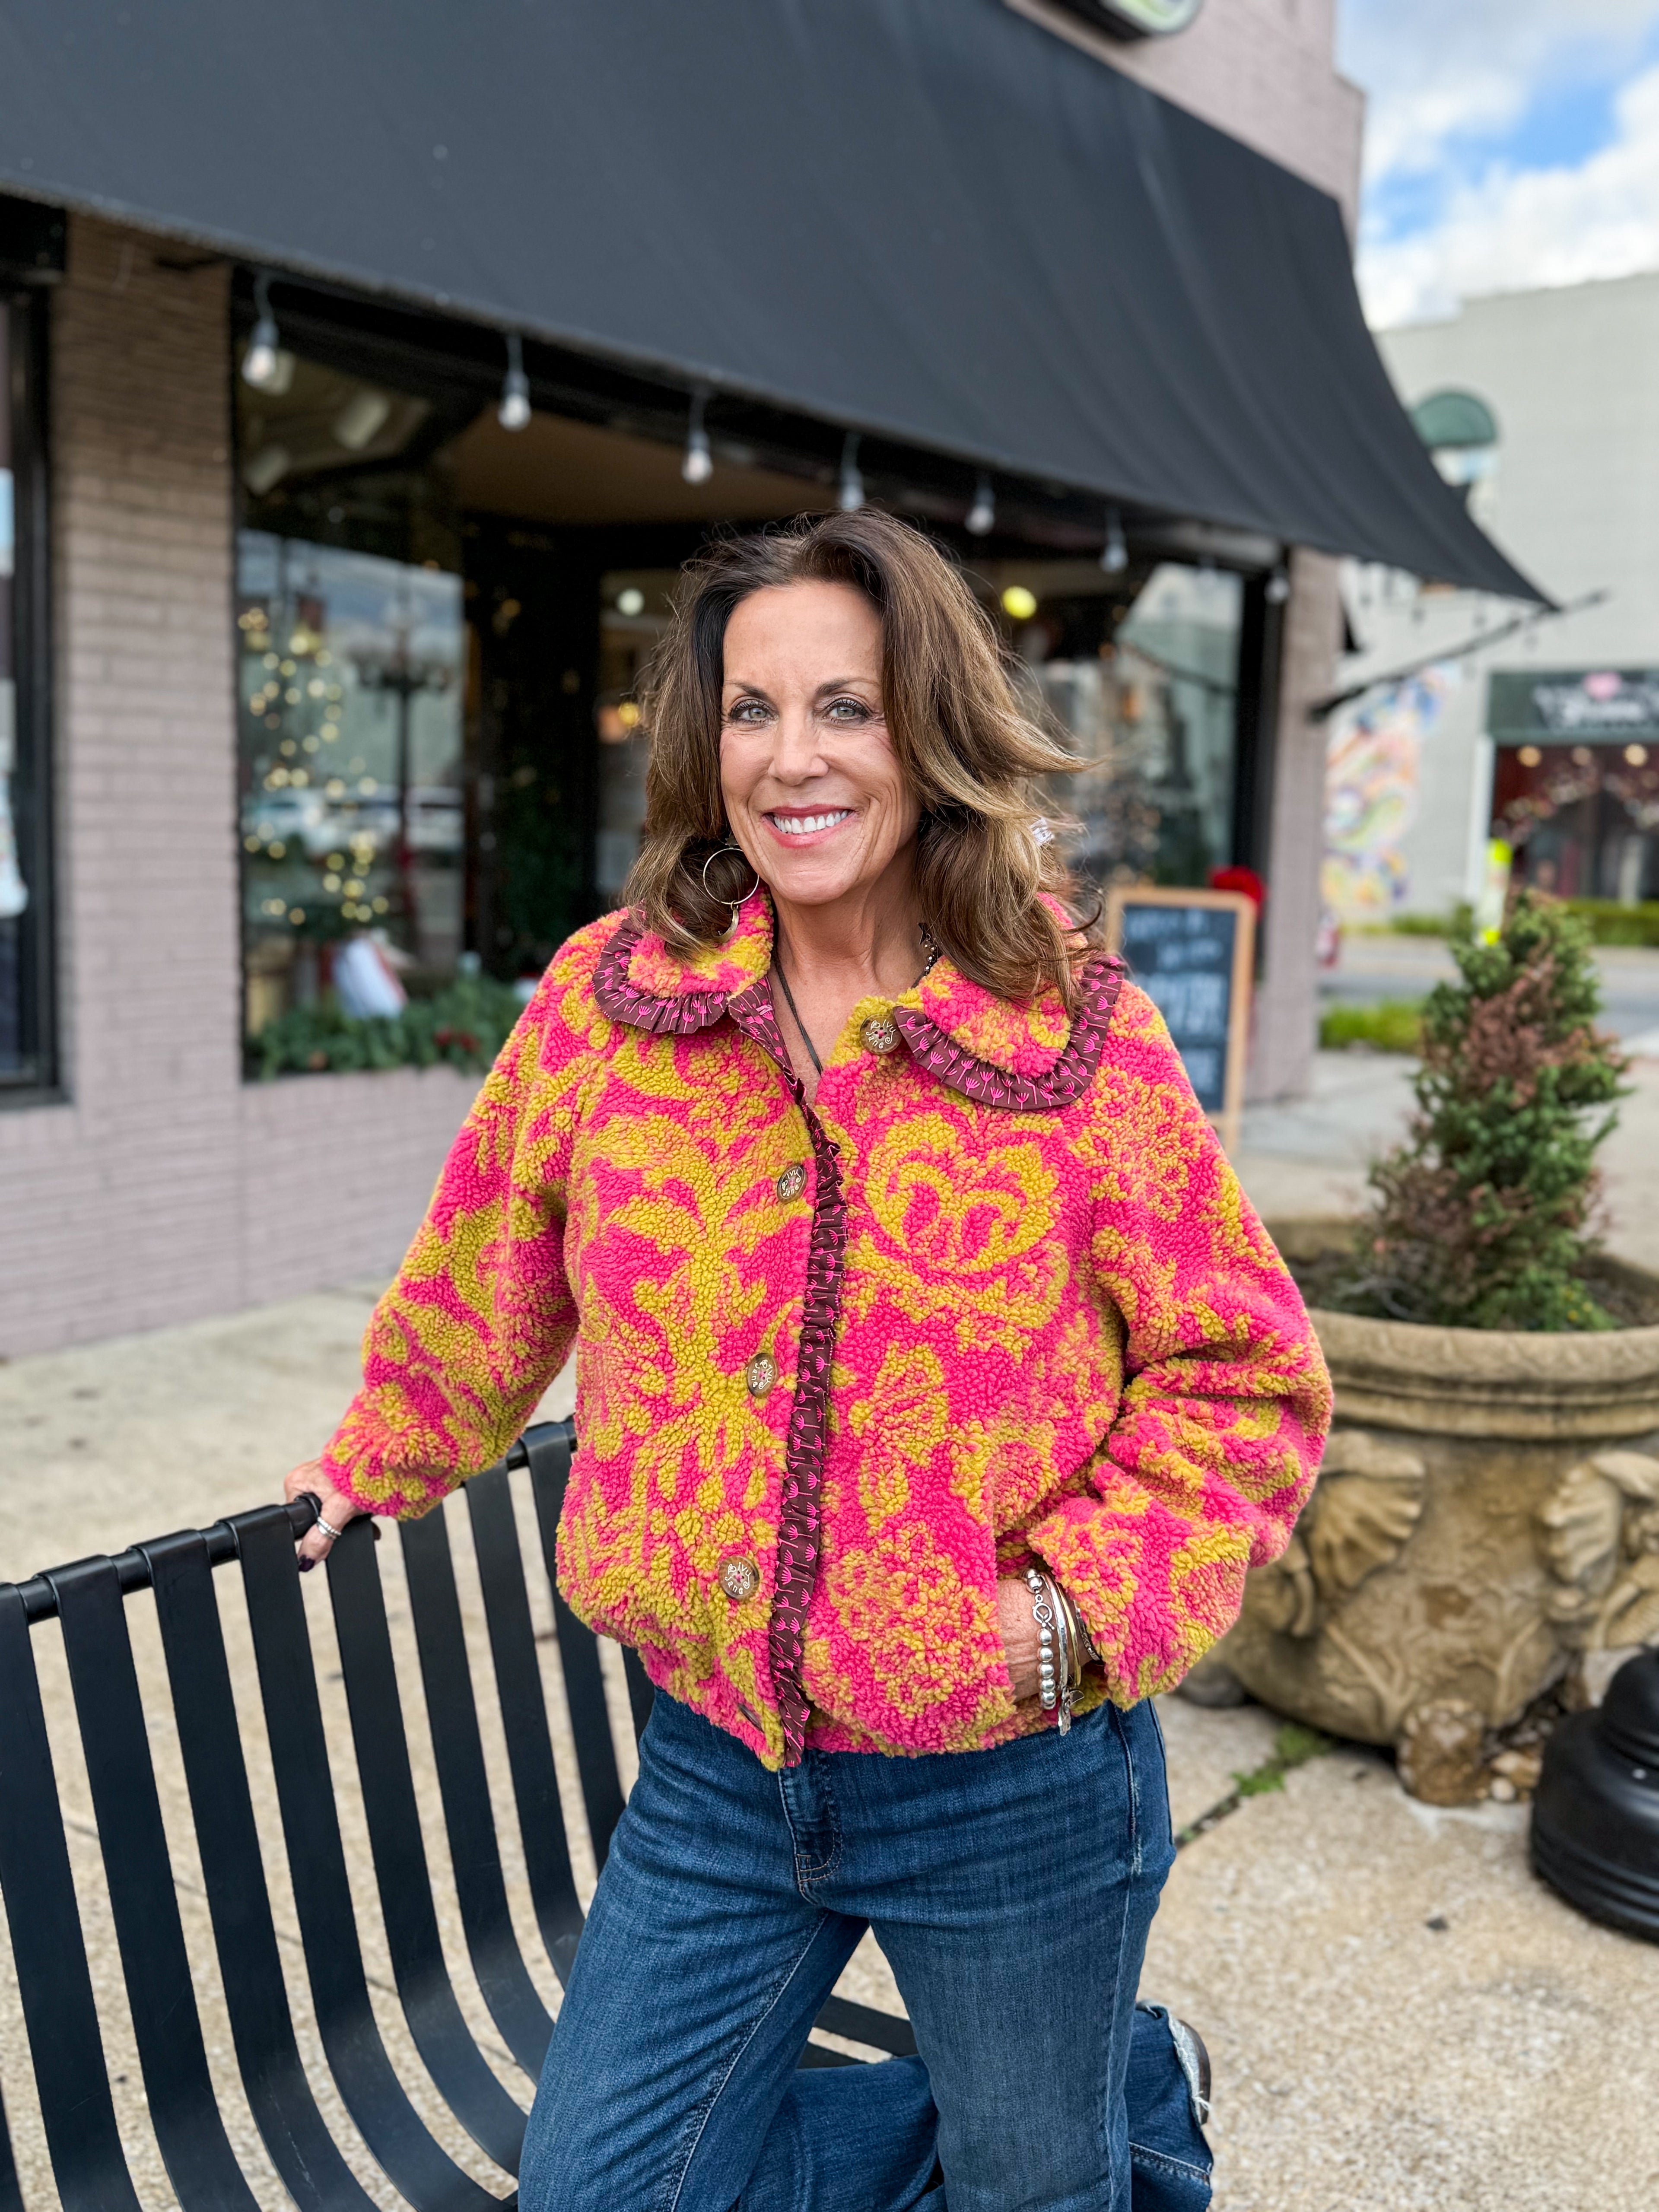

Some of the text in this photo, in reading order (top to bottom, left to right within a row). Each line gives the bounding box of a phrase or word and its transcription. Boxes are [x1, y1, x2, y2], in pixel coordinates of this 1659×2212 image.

[882, 1019, 896, 1044] Ivy
[787, 1169, 801, 1183] Ivy
[738, 1562, 752, 1589] Ivy
